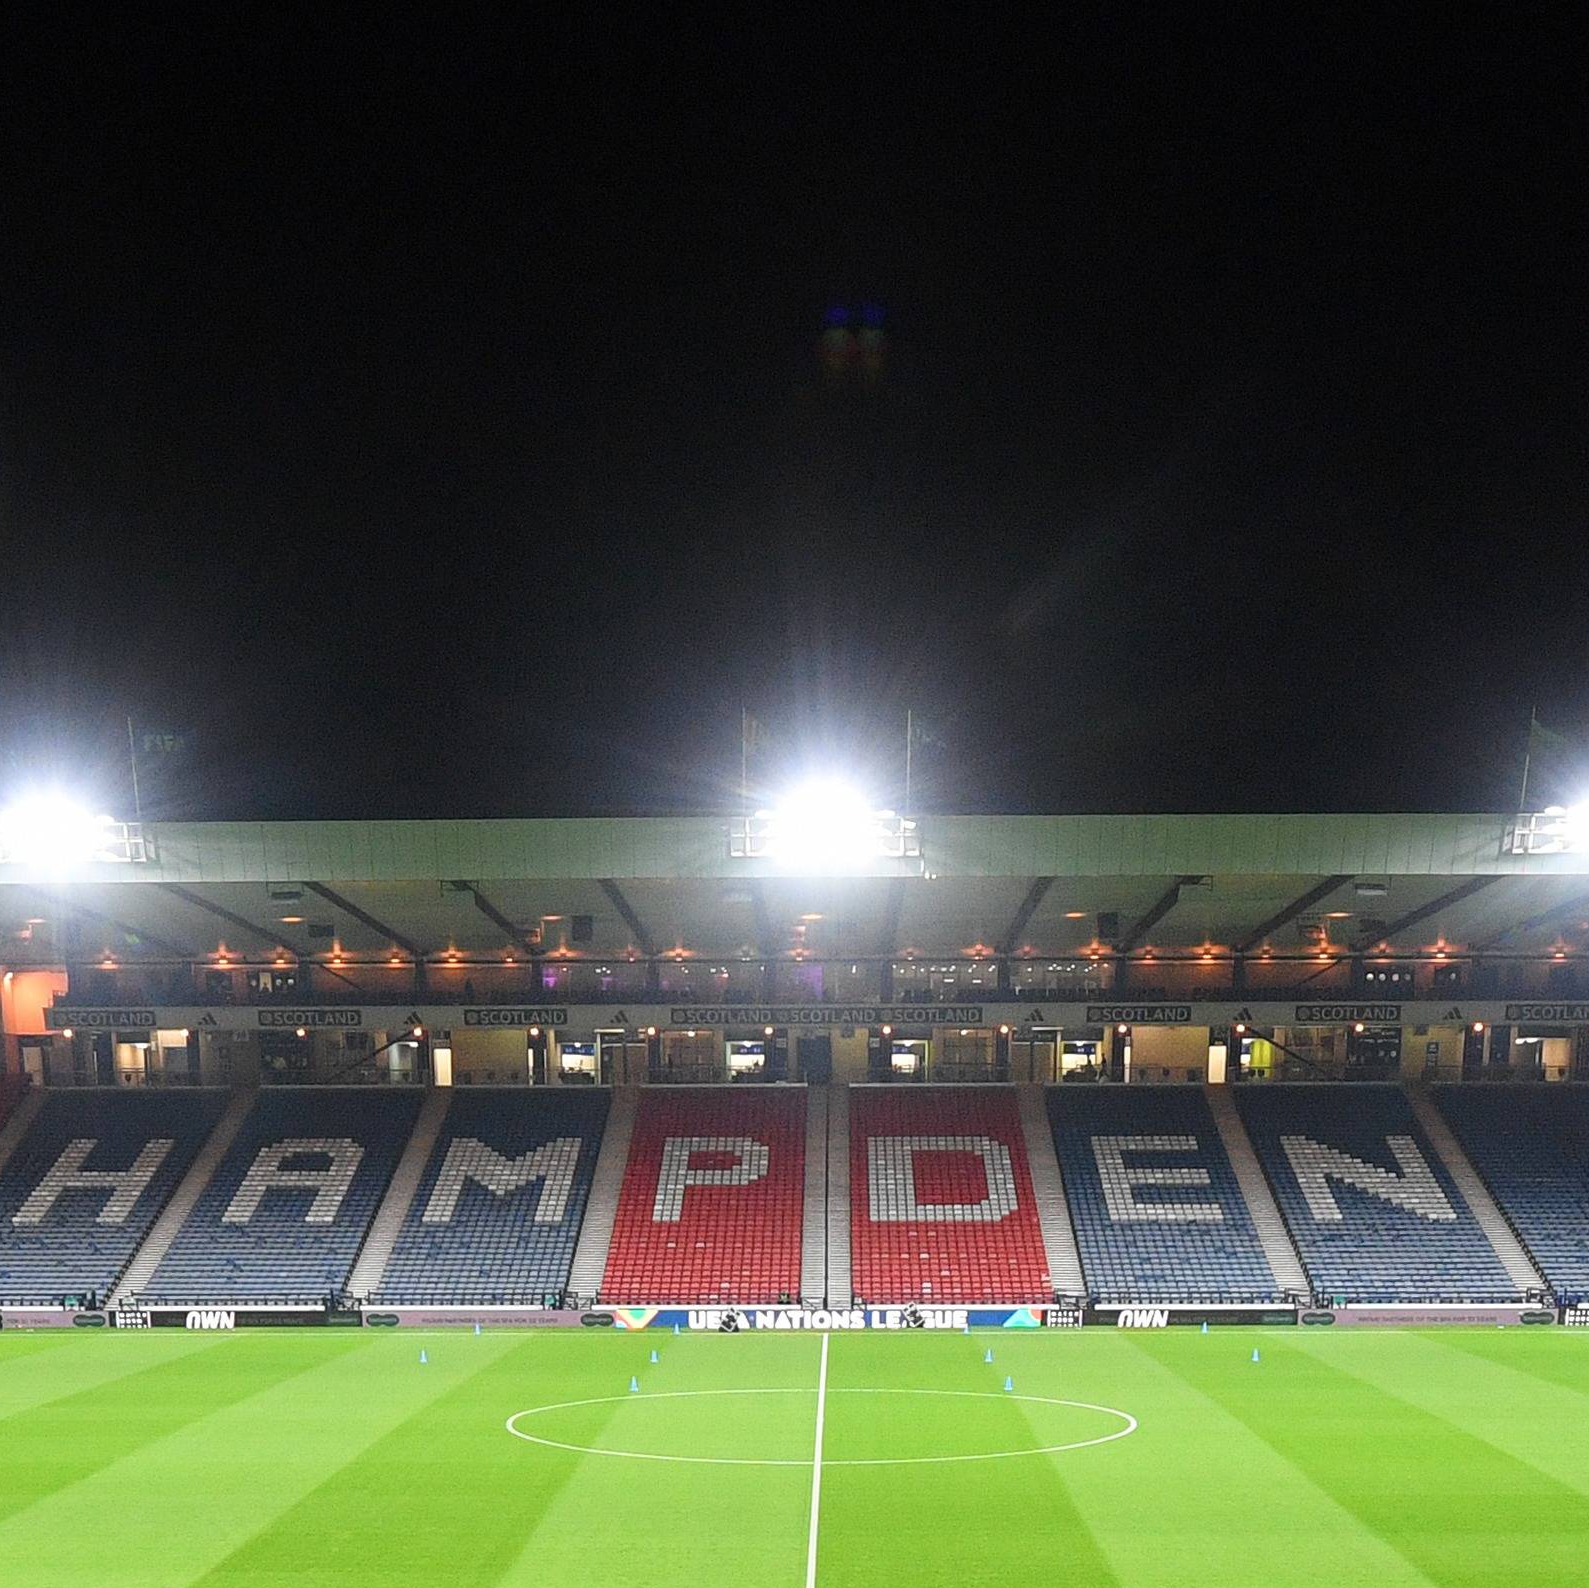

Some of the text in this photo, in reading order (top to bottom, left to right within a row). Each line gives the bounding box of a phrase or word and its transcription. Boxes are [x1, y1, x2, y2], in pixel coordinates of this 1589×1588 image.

[68, 1012, 154, 1026] SCOTLAND
[274, 1012, 360, 1026] SCOTLAND
[479, 1011, 565, 1025] SCOTLAND
[687, 1010, 772, 1023] SCOTLAND
[789, 1010, 875, 1023] SCOTLAND
[894, 1009, 980, 1022] SCOTLAND
[1102, 1008, 1188, 1021] SCOTLAND
[1312, 1006, 1398, 1020] SCOTLAND
[11, 1136, 1458, 1222] HAMPDEN
[185, 1311, 236, 1329] OWN
[688, 1310, 968, 1328] UEA NATIONS LEGUE
[1117, 1310, 1169, 1328] OWN
